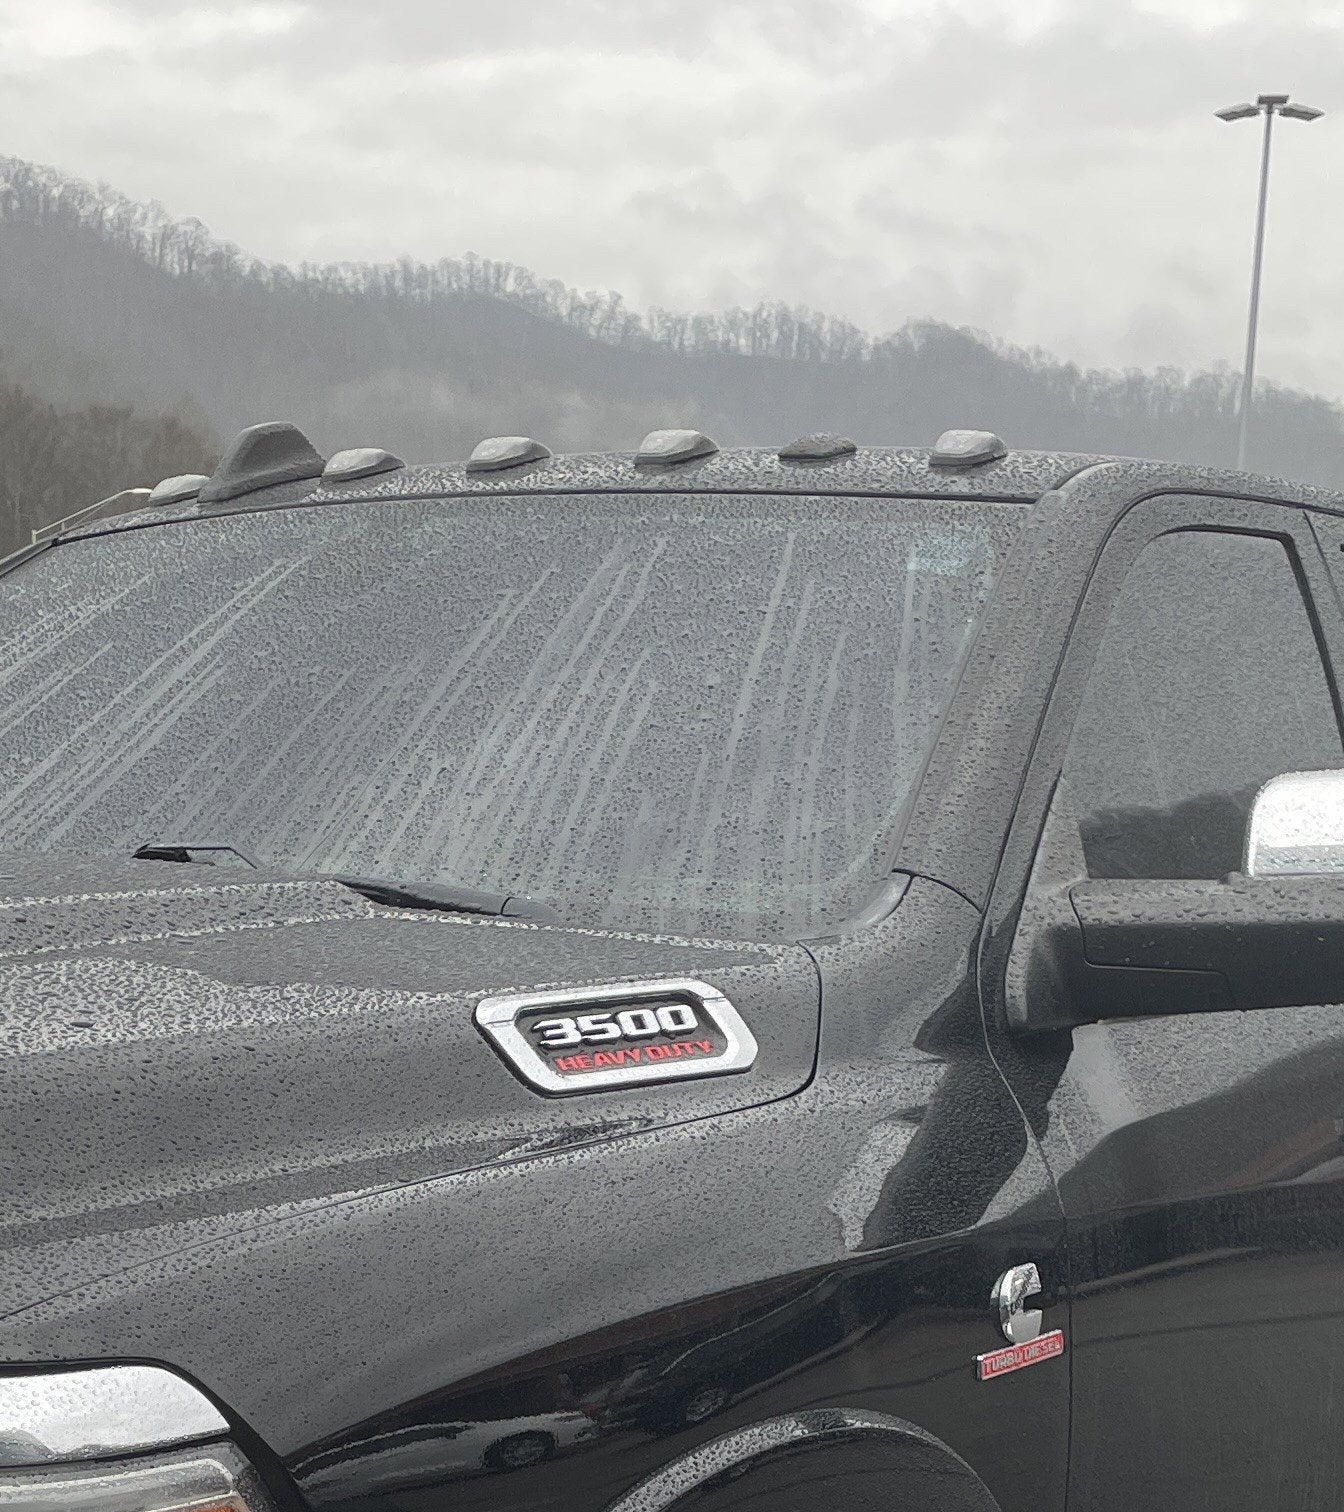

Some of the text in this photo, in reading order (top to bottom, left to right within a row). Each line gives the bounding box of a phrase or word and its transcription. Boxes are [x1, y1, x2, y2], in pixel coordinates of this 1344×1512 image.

[531, 1004, 699, 1050] 3500
[555, 1039, 712, 1072] HEAVY DUTY
[981, 1346, 1023, 1377] TURBO
